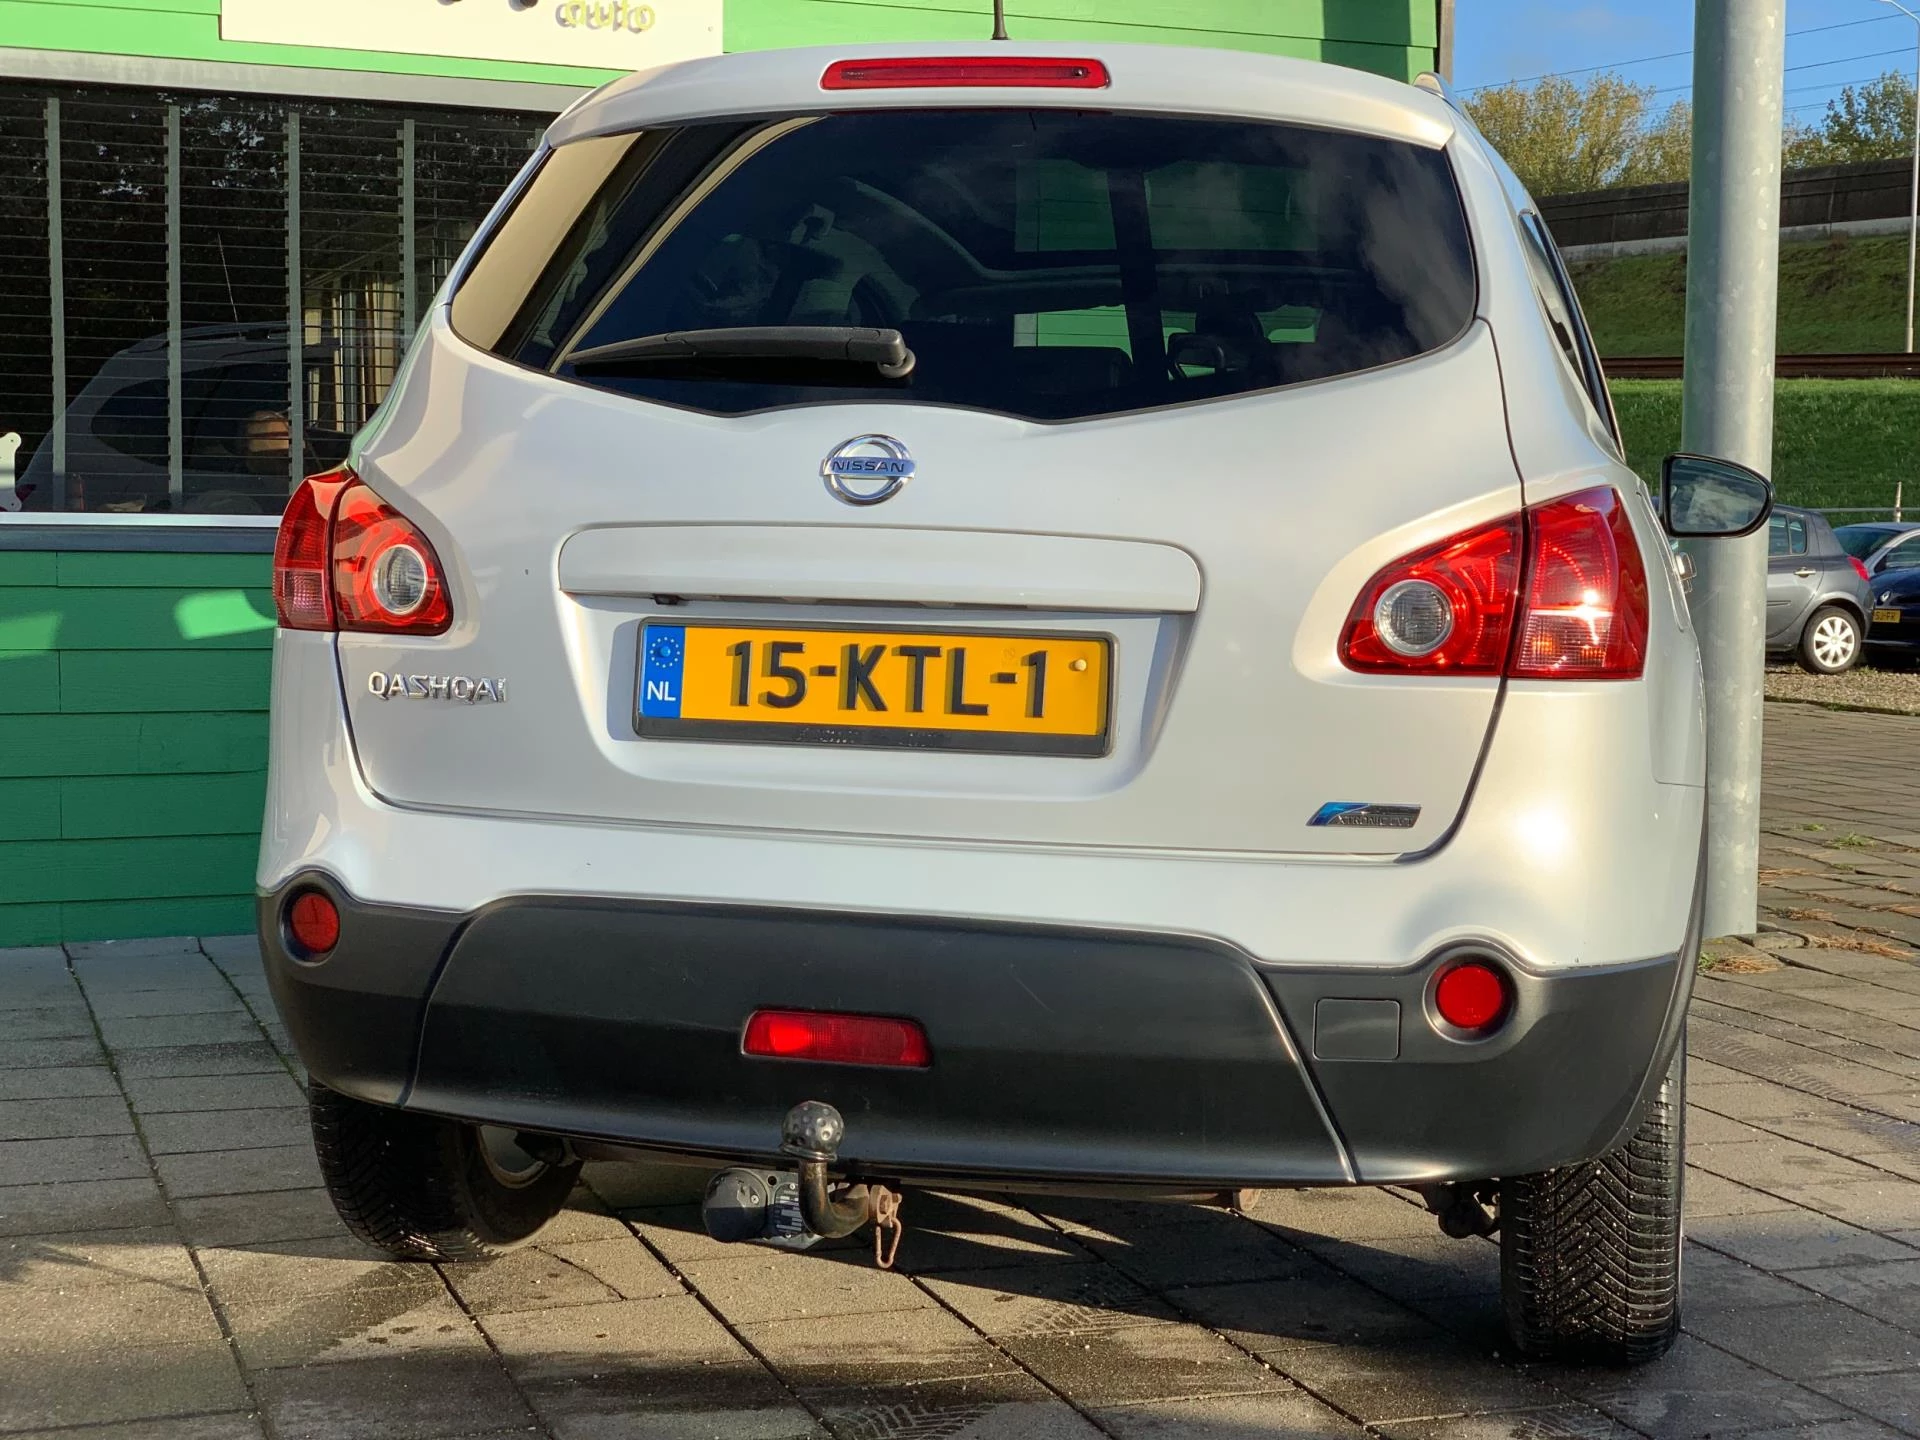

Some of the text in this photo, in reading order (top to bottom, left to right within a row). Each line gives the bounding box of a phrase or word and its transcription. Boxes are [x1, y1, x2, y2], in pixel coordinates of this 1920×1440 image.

[562, 0, 656, 31] auto
[831, 459, 905, 473] NISSAN
[368, 671, 507, 705] QASHQAI
[646, 680, 677, 701] NL
[728, 640, 1048, 719] 15-KTL-1
